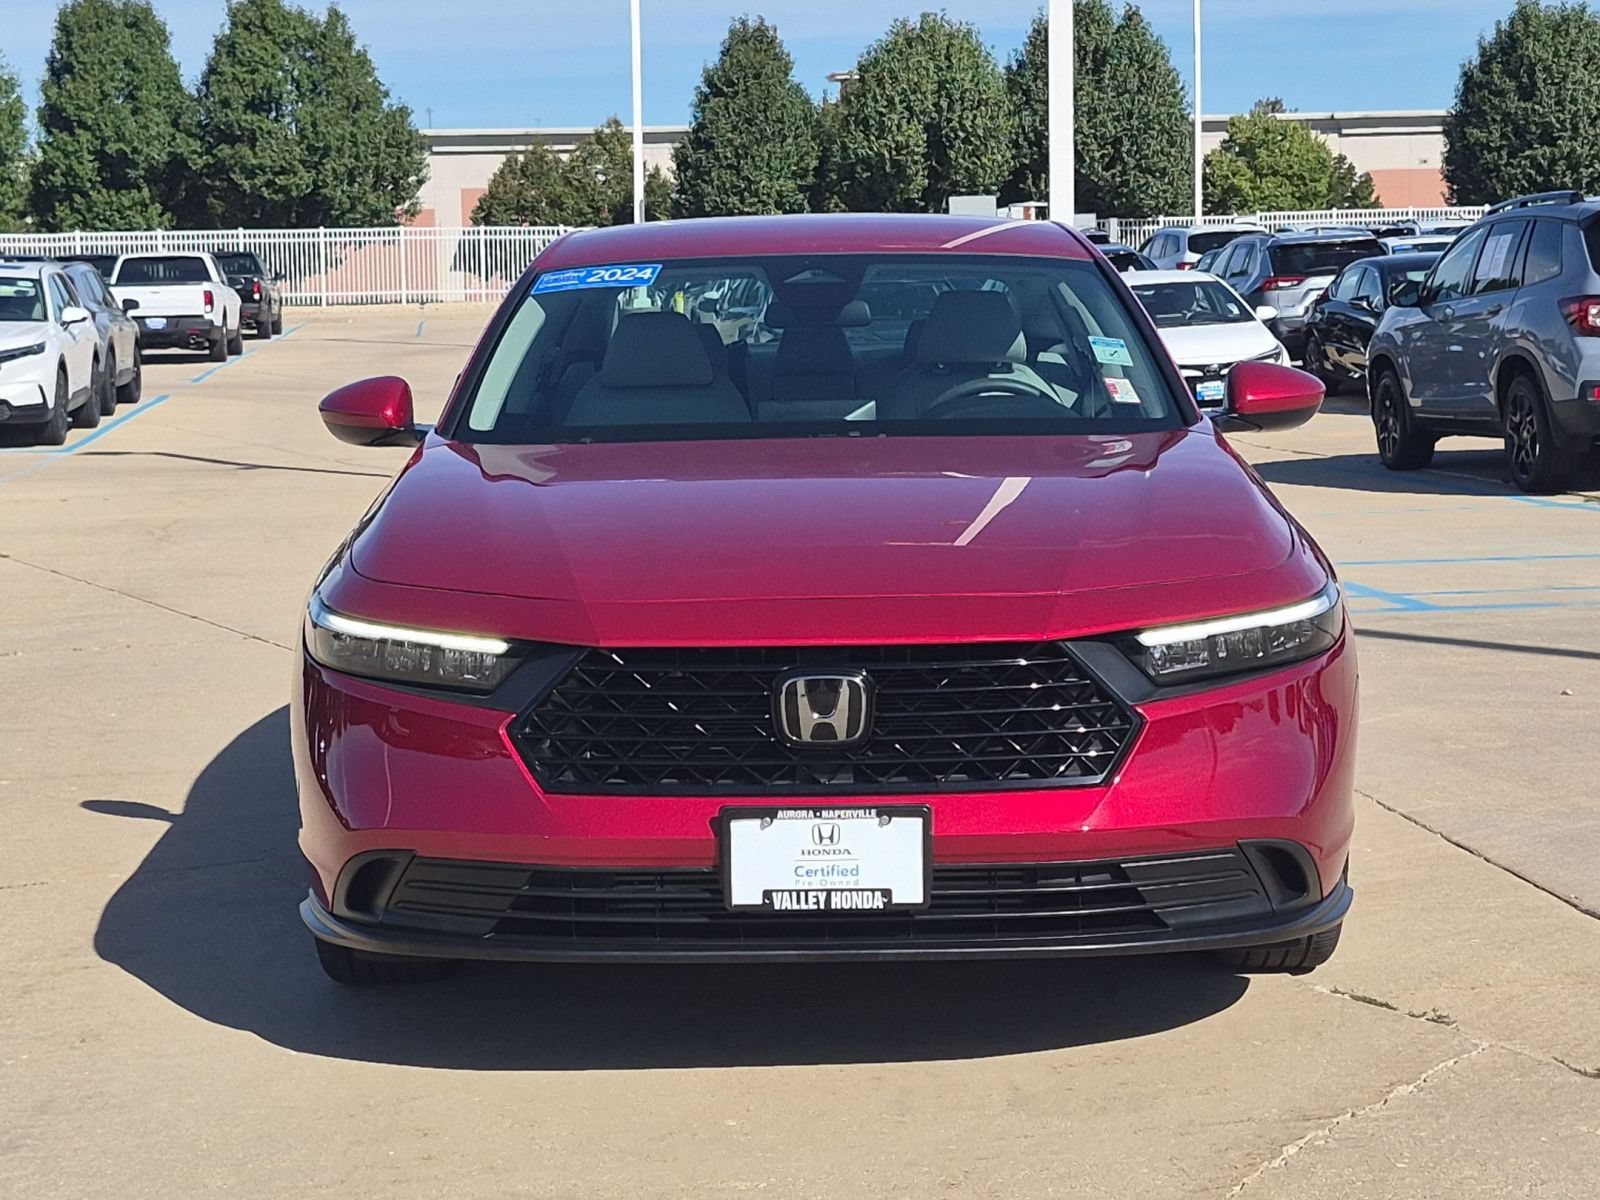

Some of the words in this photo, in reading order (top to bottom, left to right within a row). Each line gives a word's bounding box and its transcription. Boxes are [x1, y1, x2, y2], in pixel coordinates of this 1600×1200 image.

[586, 268, 653, 282] 2024
[777, 810, 814, 819] AURORA
[821, 809, 877, 819] NAPERVILLE
[794, 864, 859, 877] Certified
[771, 891, 827, 910] VALLEY
[830, 890, 884, 909] HONDA
